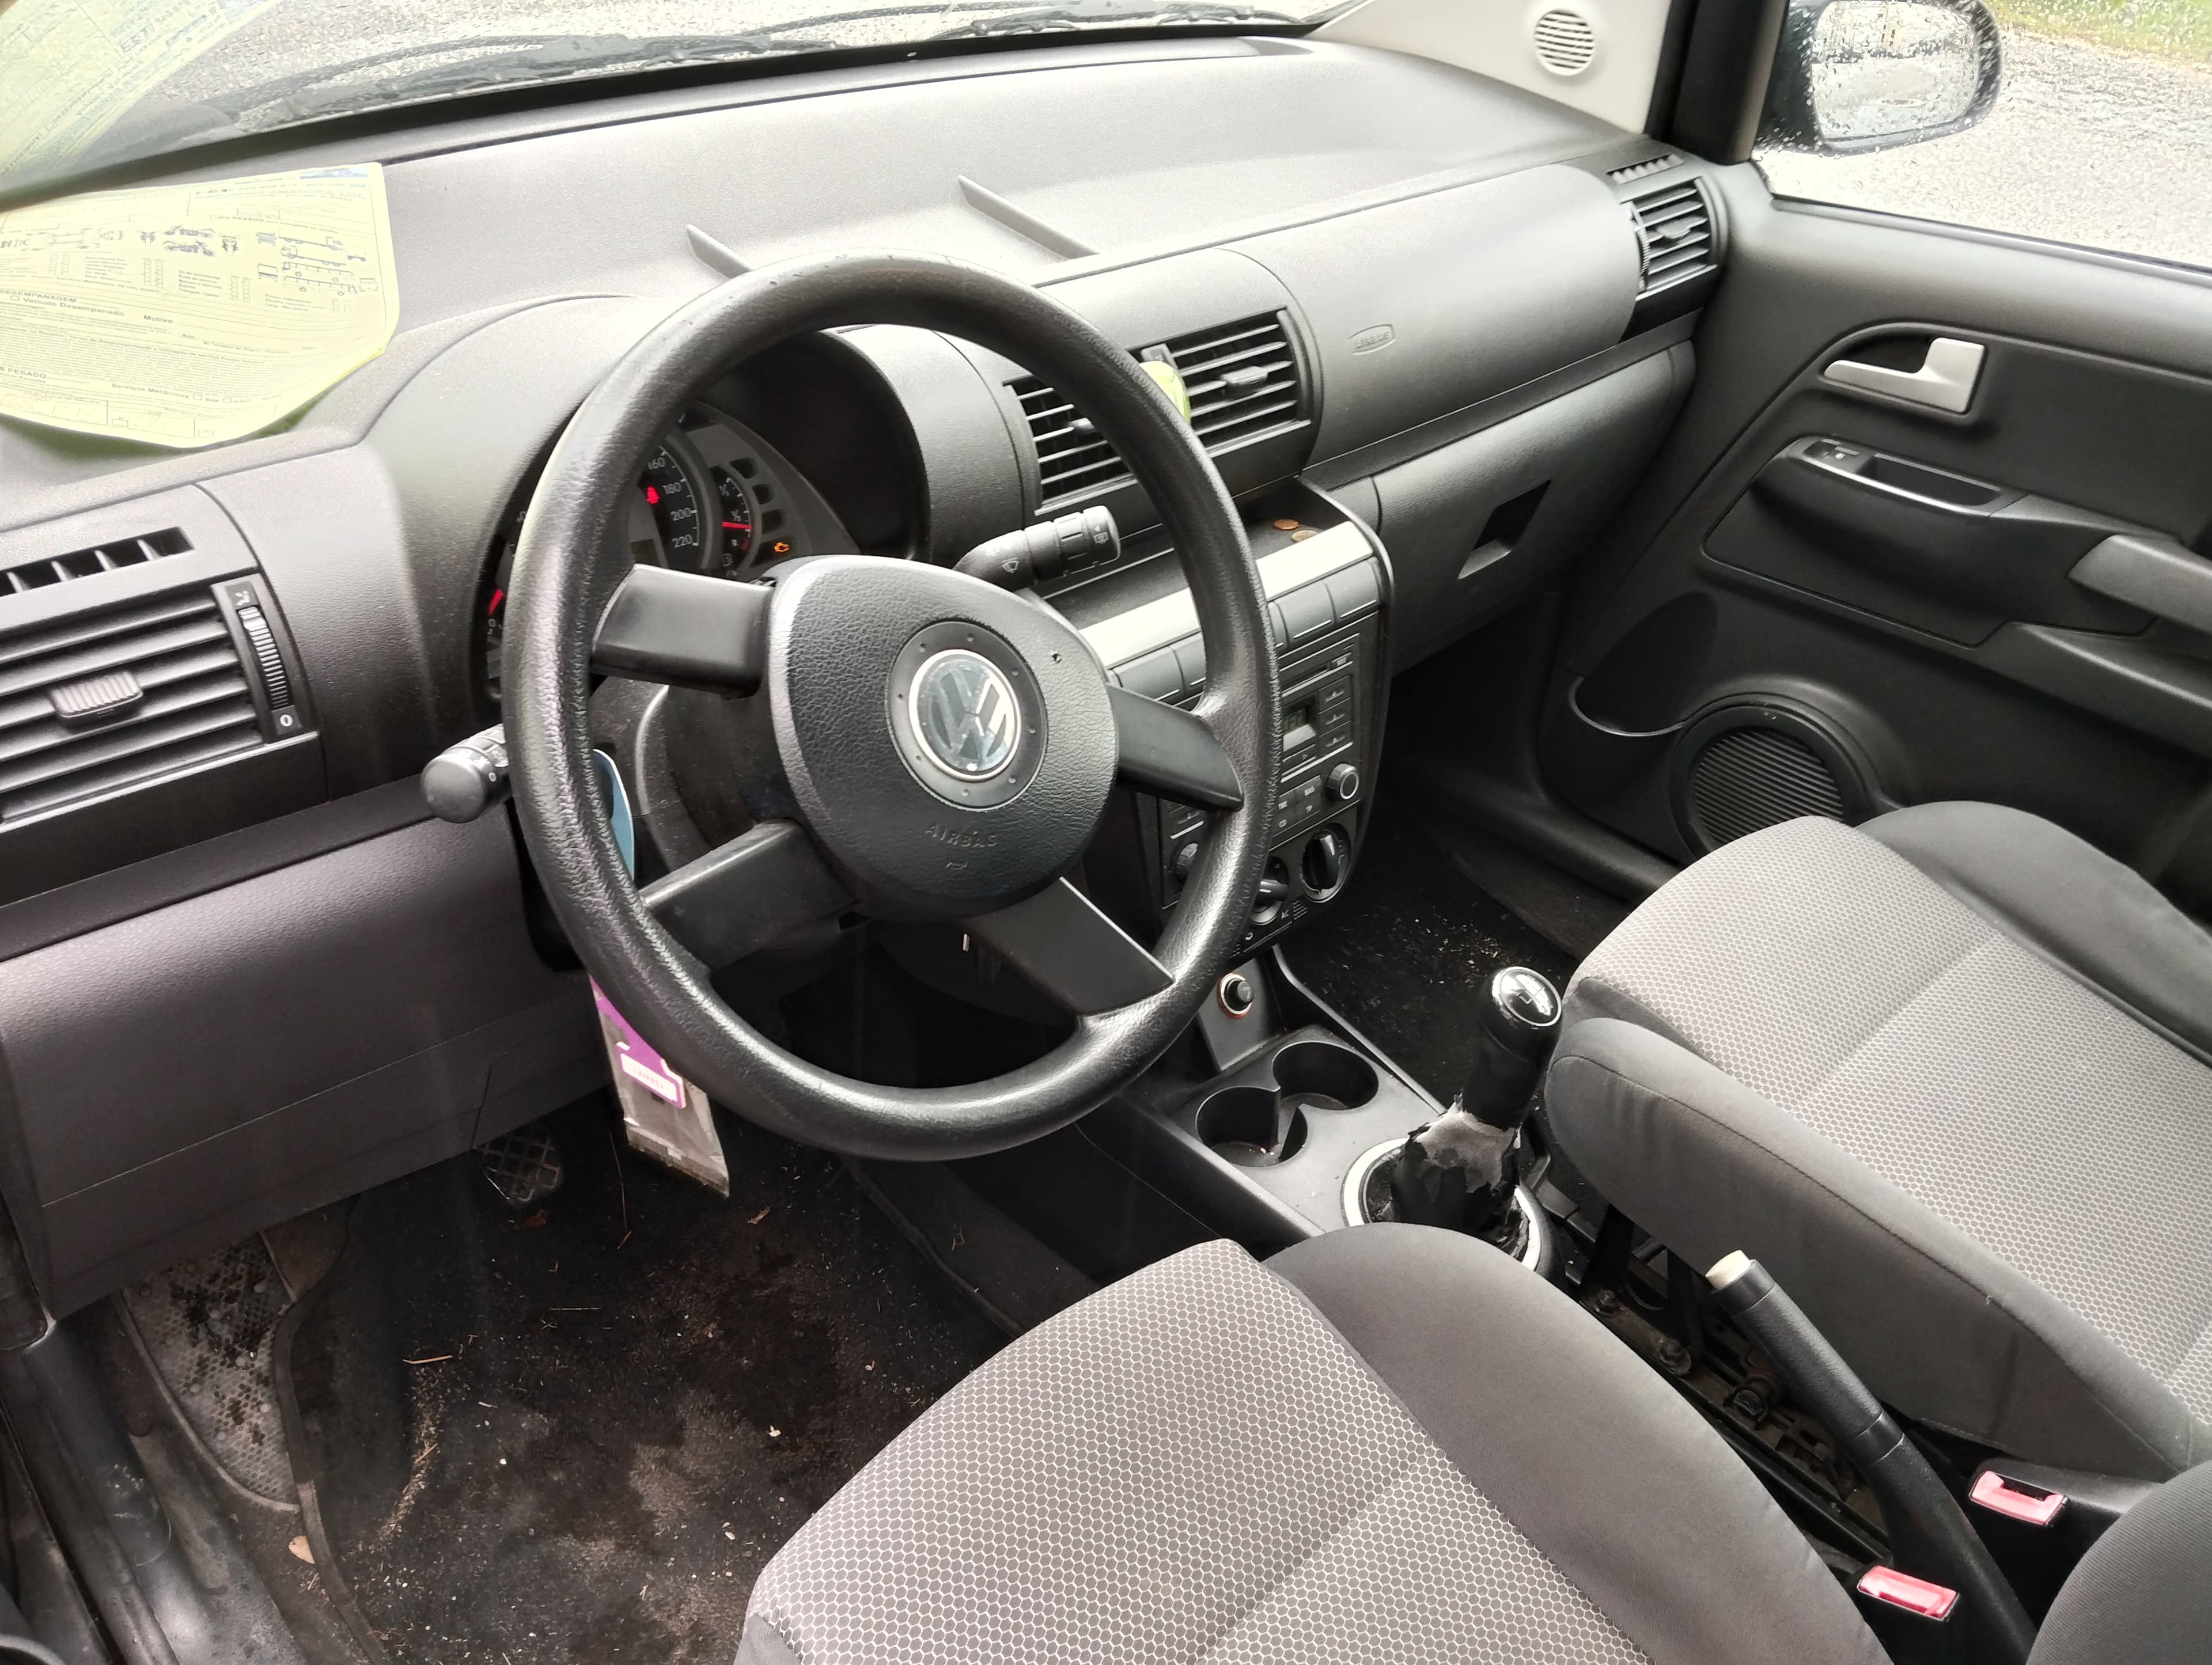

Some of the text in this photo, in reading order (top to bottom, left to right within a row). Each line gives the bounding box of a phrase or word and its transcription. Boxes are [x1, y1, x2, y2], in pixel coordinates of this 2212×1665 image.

[60, 302, 124, 317] Desempanado
[143, 314, 173, 324] Motivo
[8, 367, 47, 378] PESADO
[647, 457, 665, 470] 160
[662, 482, 682, 495] 180
[670, 507, 692, 521] 200
[672, 534, 694, 548] 220
